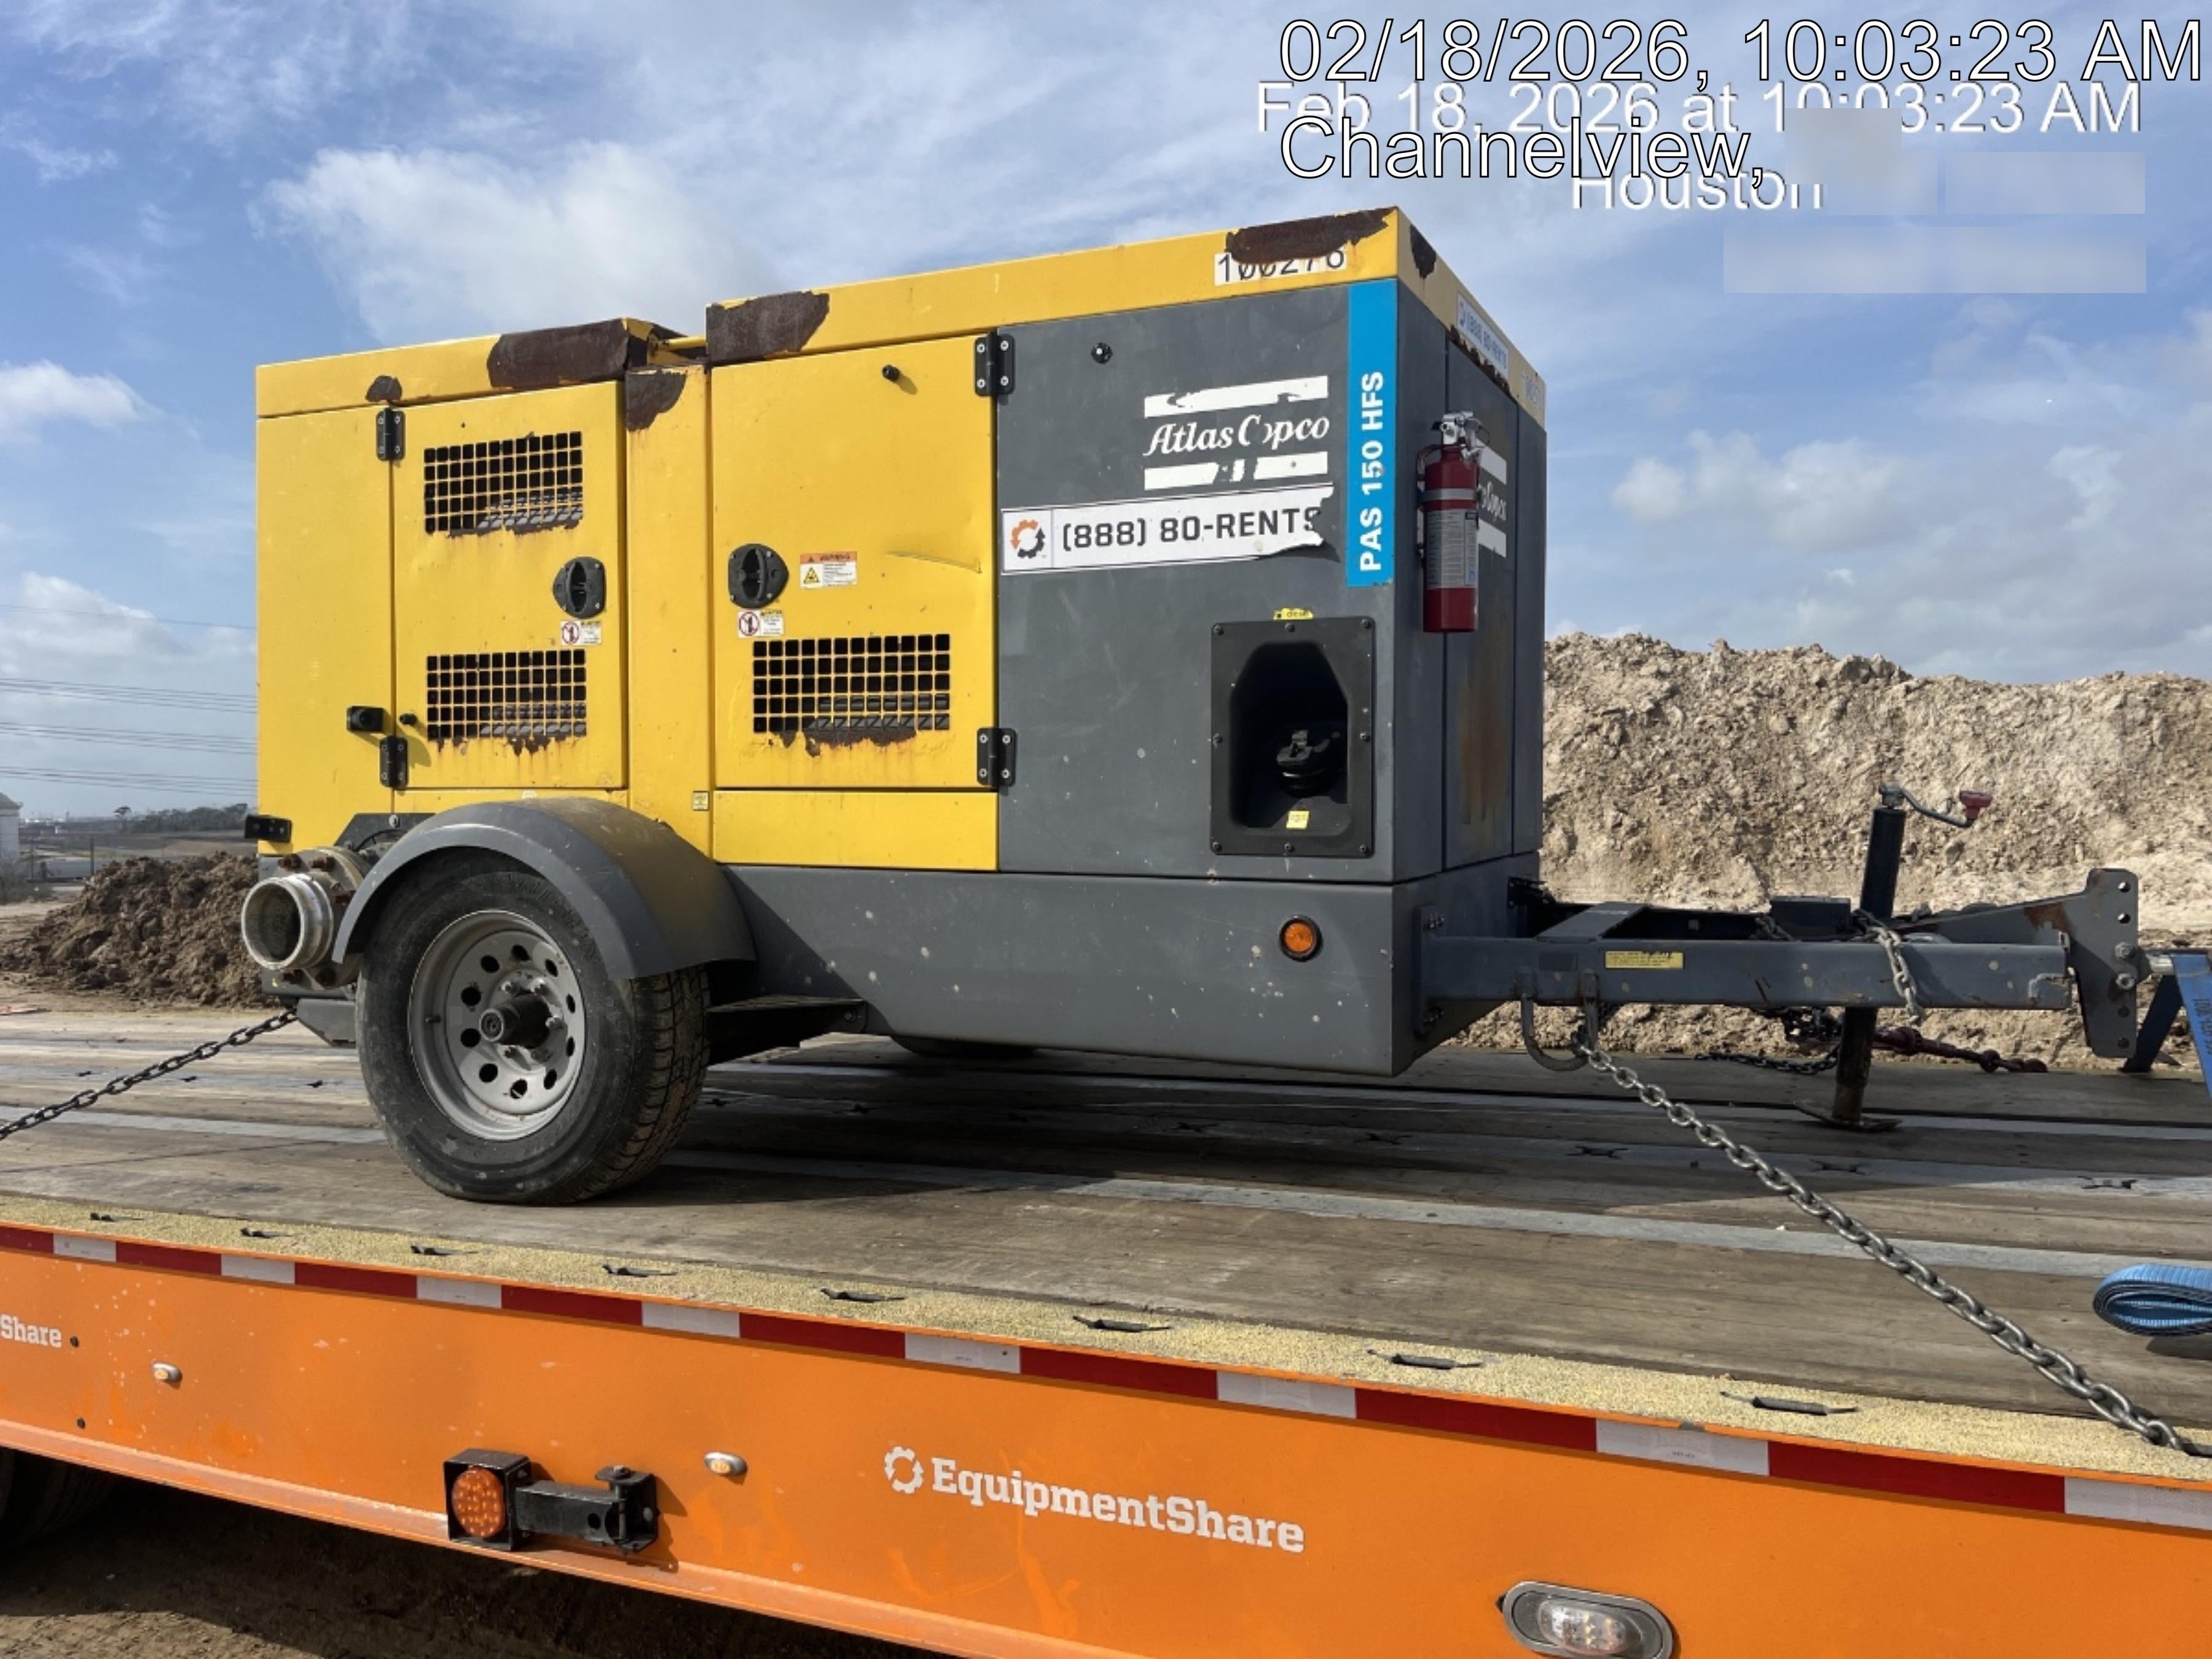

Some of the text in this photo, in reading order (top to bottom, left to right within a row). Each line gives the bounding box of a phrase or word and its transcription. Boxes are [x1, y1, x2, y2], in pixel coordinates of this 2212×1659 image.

[1142, 422, 1234, 457] Atlas
[1360, 372, 1385, 571] PAS 150 HFS
[931, 1457, 1304, 1553] EquipmentShare
